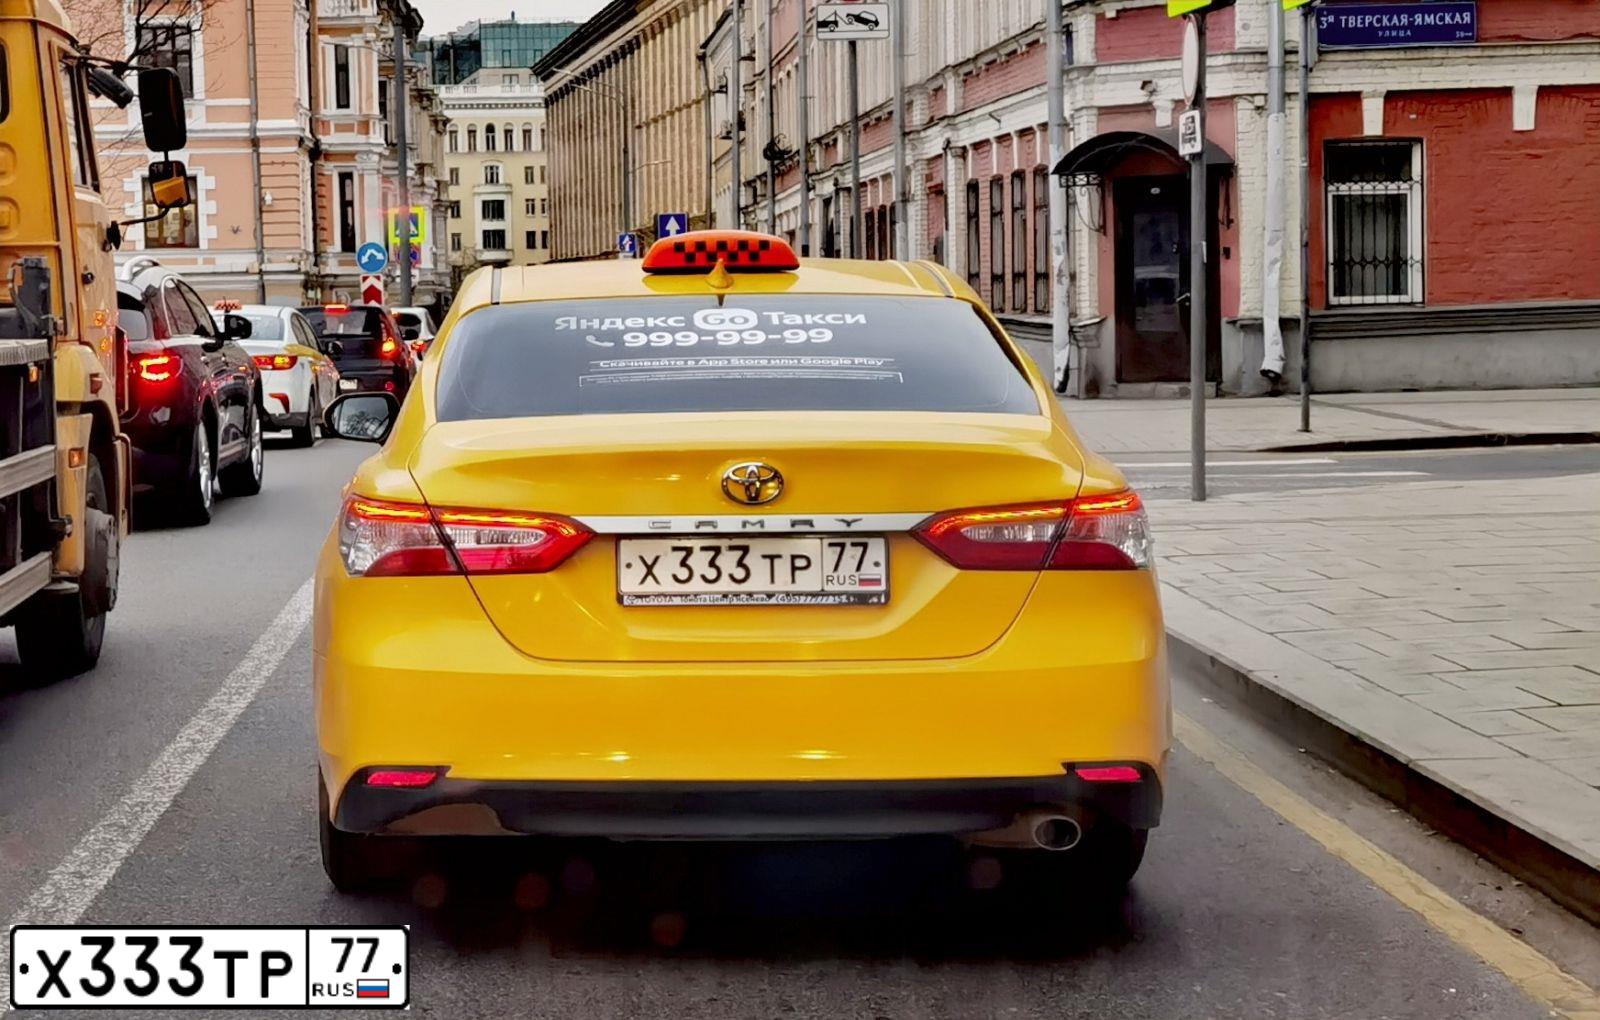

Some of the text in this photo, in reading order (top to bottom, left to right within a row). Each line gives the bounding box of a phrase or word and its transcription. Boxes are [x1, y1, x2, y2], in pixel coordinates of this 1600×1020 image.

[1340, 12, 1471, 29] ТВЕРСКАЯ-ЯМСКАЯ
[554, 311, 867, 331] Яндекс Go Такси
[622, 328, 834, 347] 999-99-99
[599, 359, 685, 368] Скачивайте
[698, 358, 728, 367] App
[730, 358, 768, 366] Store
[800, 357, 852, 366] Google
[854, 358, 885, 366] Play
[648, 518, 864, 530] CAMRY
[827, 542, 870, 573] 77
[826, 575, 858, 586] RUS
